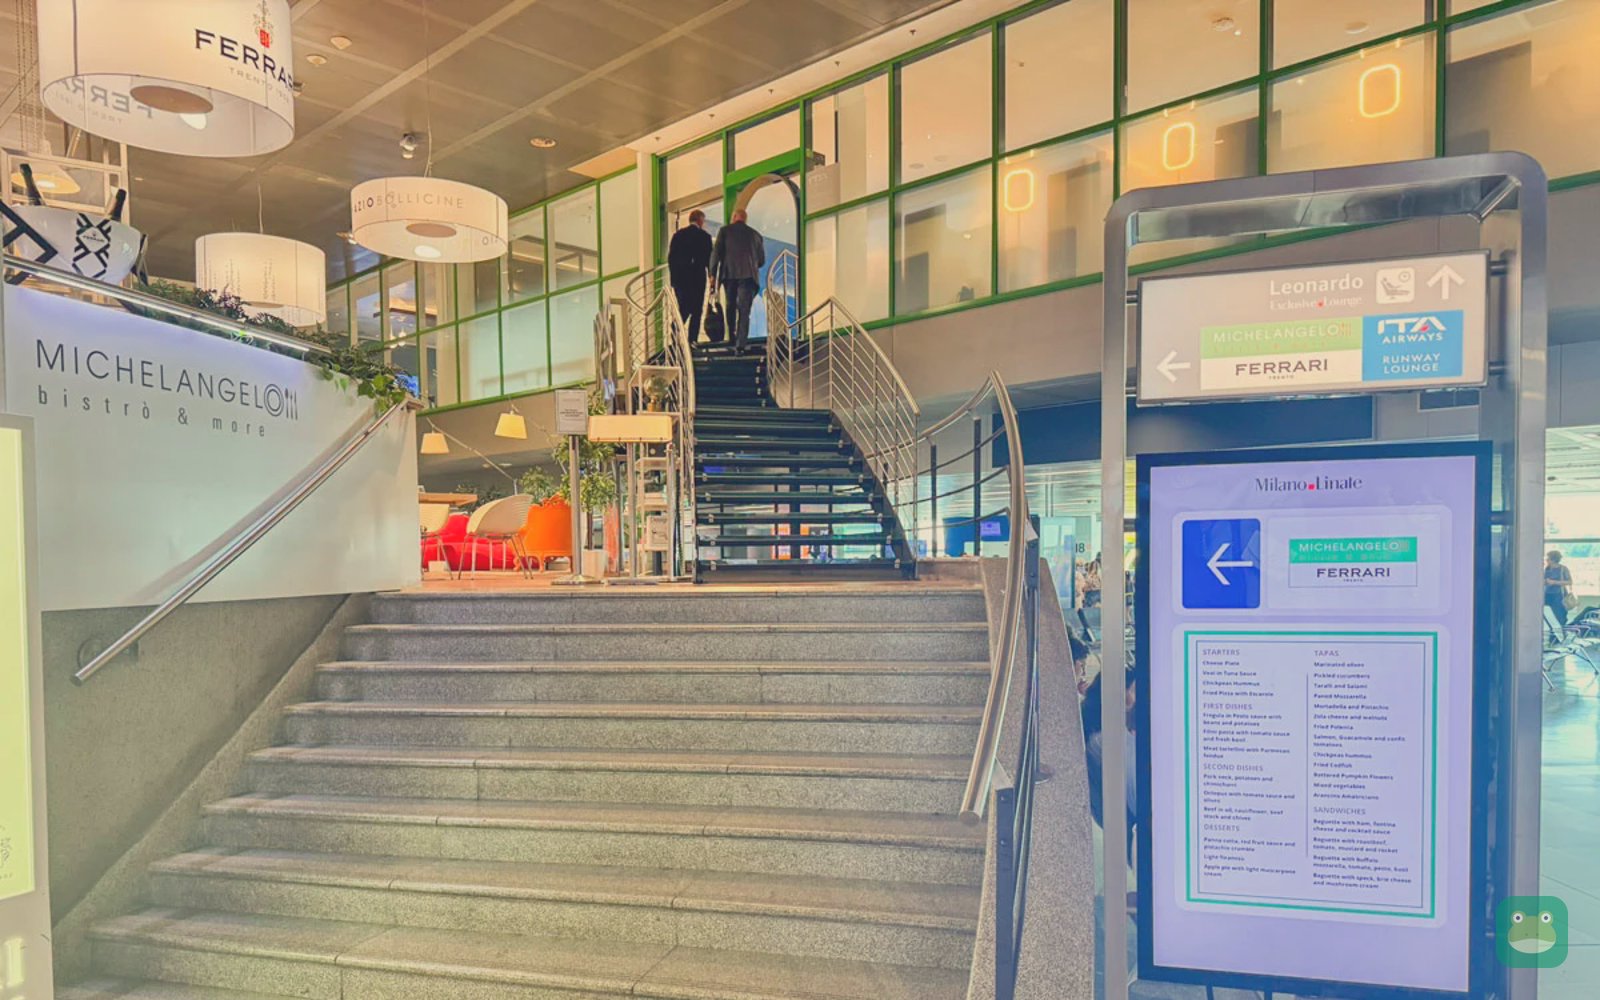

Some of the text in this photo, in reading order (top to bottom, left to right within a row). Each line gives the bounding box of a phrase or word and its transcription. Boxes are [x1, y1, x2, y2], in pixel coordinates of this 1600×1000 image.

[1269, 272, 1364, 297] Leonardo
[1377, 316, 1447, 335] ITA
[1213, 323, 1340, 344] MICHELANGELO
[1382, 332, 1444, 345] AIRWAYS
[1382, 352, 1441, 365] RUNWAY
[1235, 358, 1329, 376] FERRARI
[1383, 362, 1440, 375] LOUNGE
[35, 338, 286, 418] MICHELANGELO
[37, 384, 266, 438] bistrò & more
[1254, 475, 1364, 492] Milano Linate
[1075, 542, 1086, 554] 18
[1298, 541, 1401, 553] MICHELANGELO
[1316, 567, 1391, 579] FERRARI
[1202, 648, 1241, 656] STARTERS
[1314, 649, 1340, 657] TAPAS
[1203, 702, 1223, 710] FIRST
[1203, 763, 1264, 772] SECOND DISHES
[1313, 806, 1366, 815] SANDWICHES
[1203, 823, 1240, 832] DESSERTS
[1313, 818, 1341, 826] Baguette
[1313, 836, 1341, 844] Baguette
[1313, 854, 1341, 862] Baguette
[1313, 872, 1341, 880] Baguette
